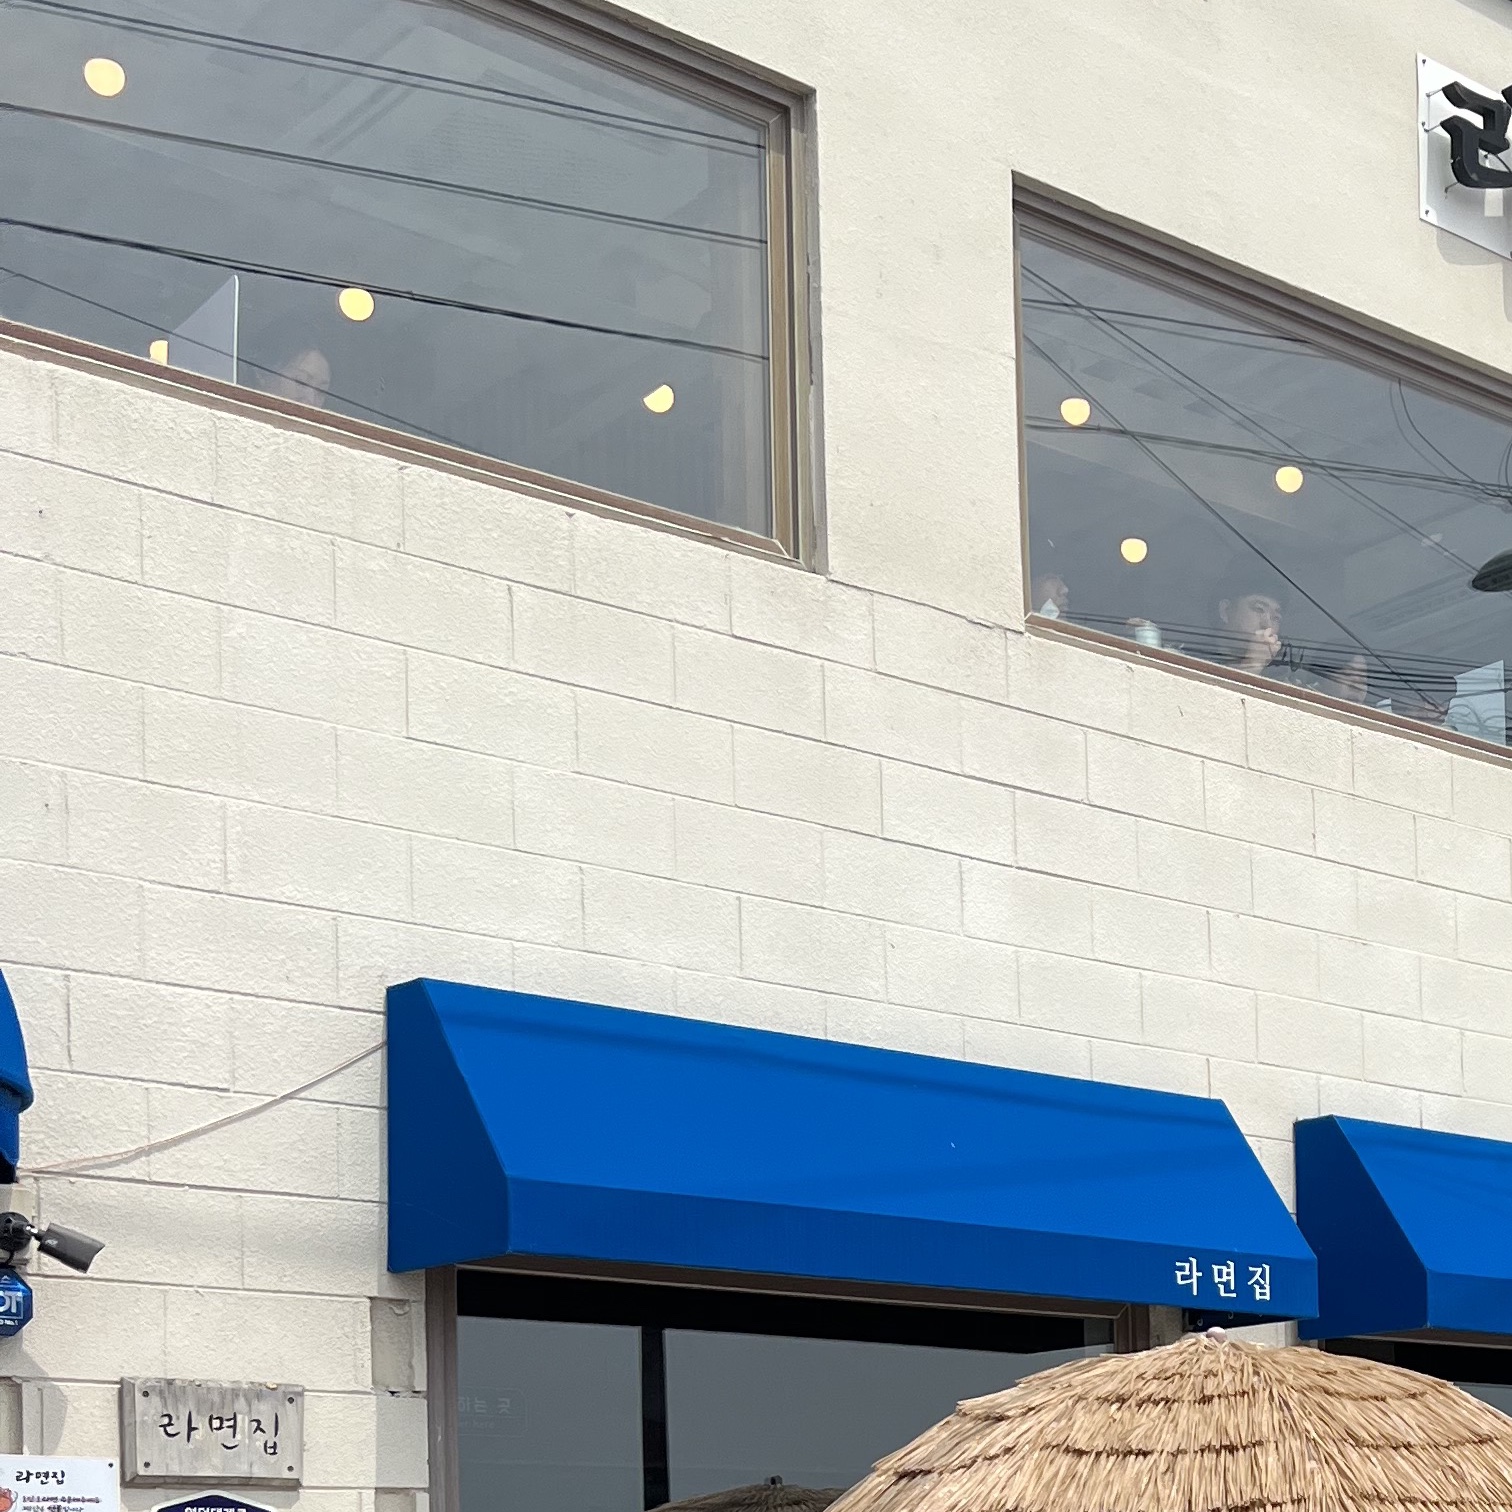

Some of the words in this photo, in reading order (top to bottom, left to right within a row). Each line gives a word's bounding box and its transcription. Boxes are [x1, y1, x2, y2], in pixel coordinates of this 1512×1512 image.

[1174, 1256, 1271, 1301] 라면집
[158, 1411, 280, 1456] 라면집
[15, 1469, 66, 1486] 라면집
